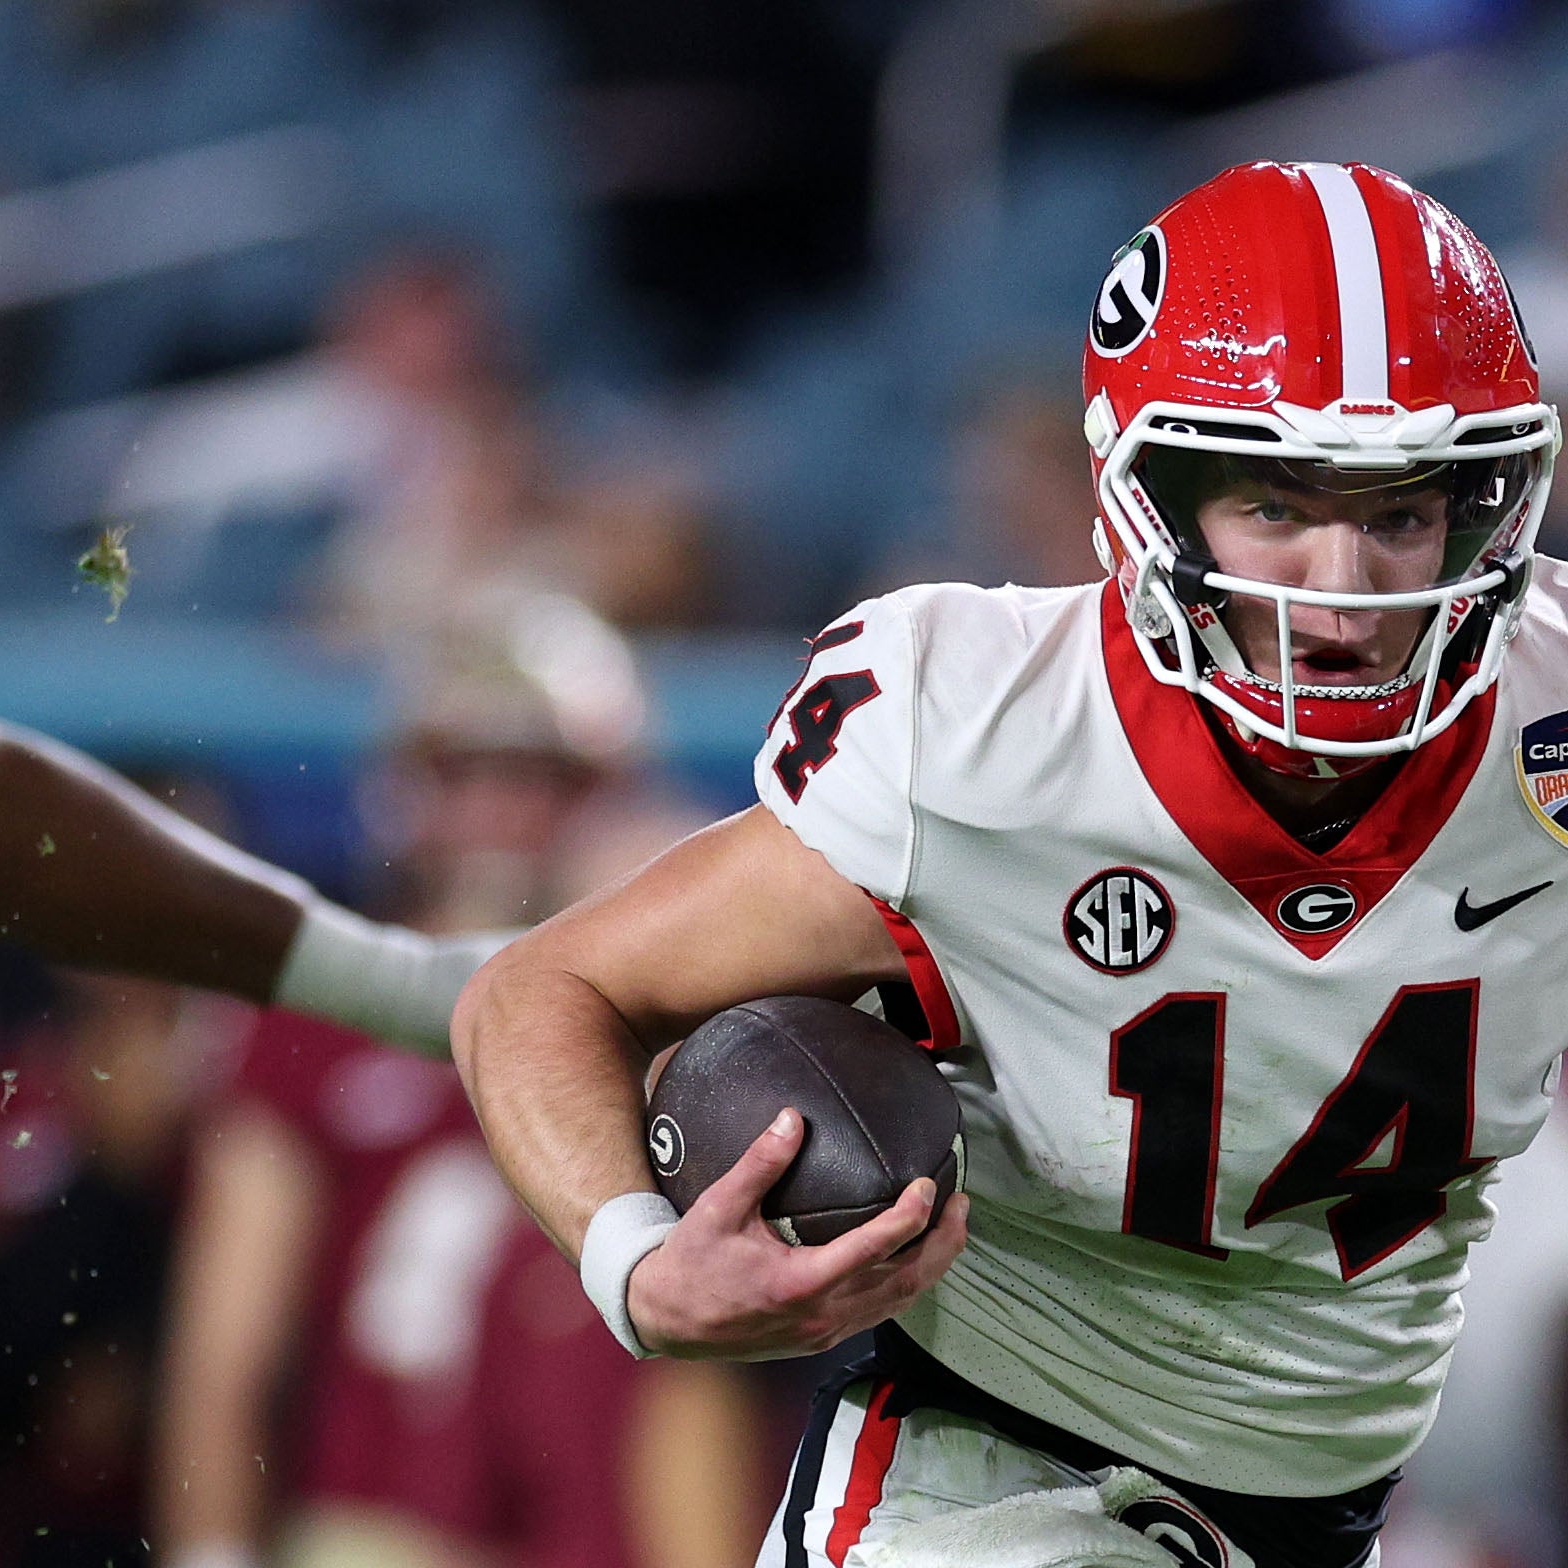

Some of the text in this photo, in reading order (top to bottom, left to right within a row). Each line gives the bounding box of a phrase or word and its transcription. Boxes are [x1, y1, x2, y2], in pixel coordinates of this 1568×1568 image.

[1091, 226, 1167, 351] G
[1074, 876, 1164, 966] SEC
[1278, 884, 1356, 934] G
[1108, 977, 1496, 1282] 14
